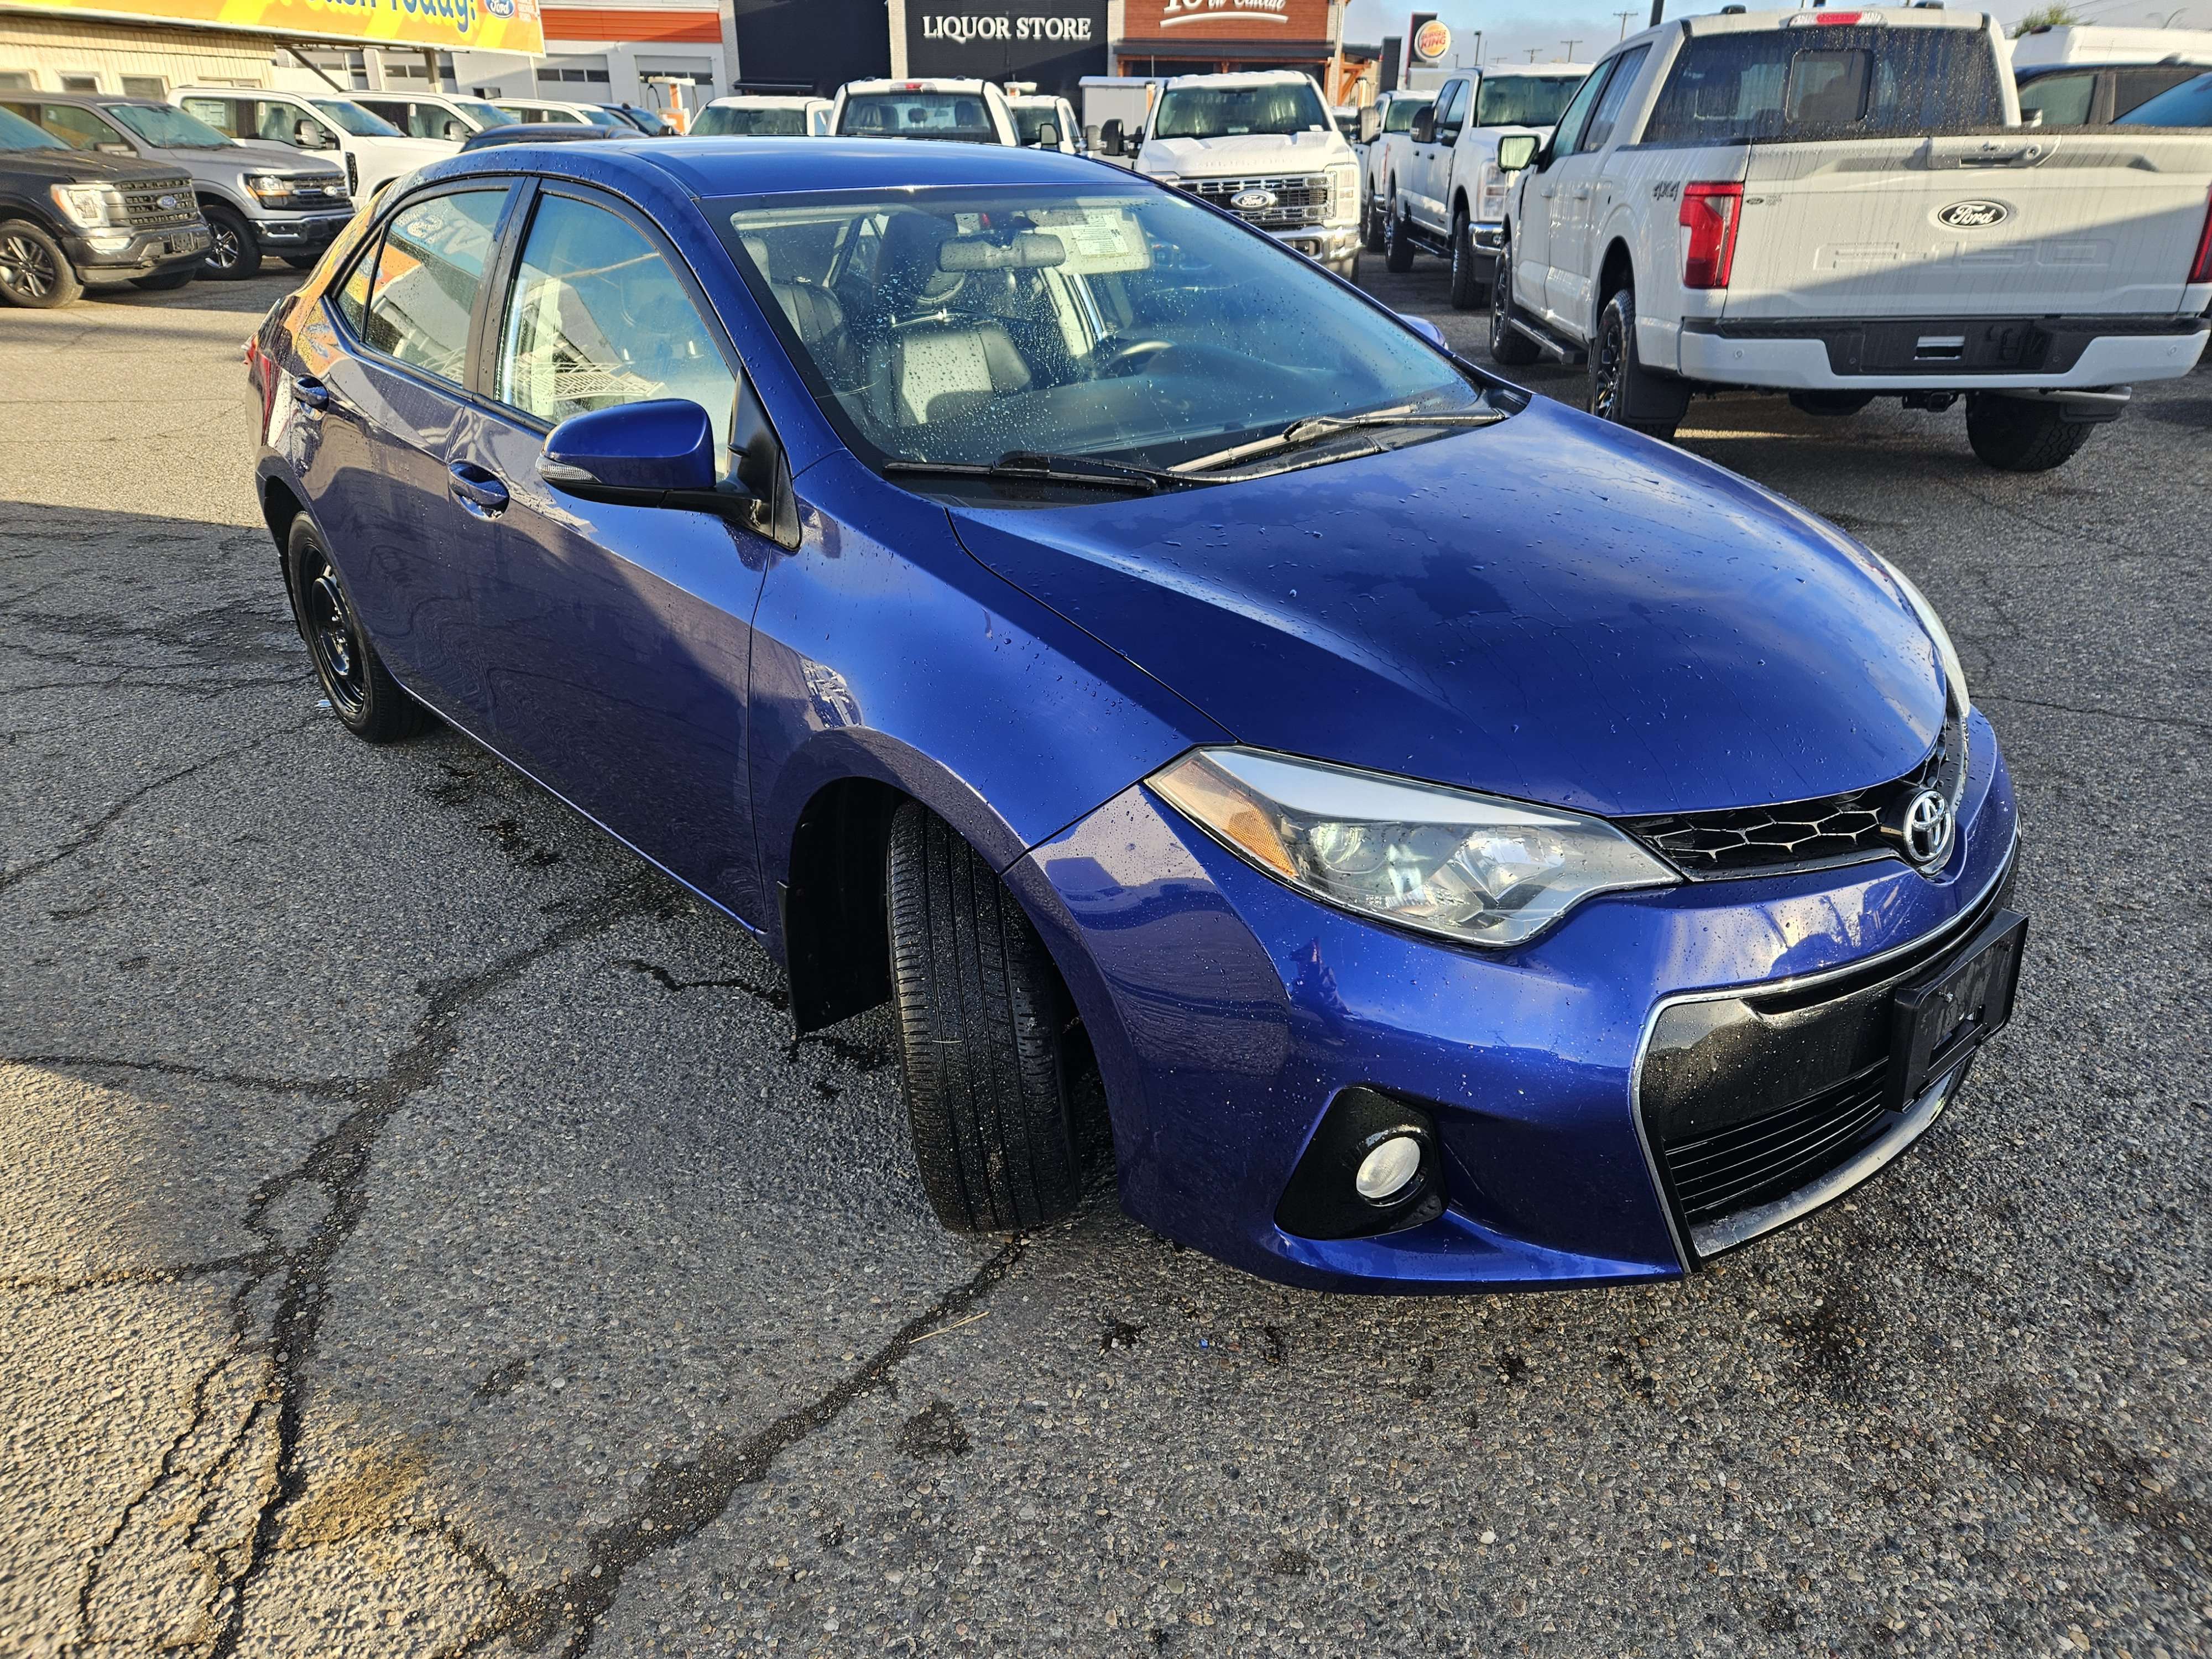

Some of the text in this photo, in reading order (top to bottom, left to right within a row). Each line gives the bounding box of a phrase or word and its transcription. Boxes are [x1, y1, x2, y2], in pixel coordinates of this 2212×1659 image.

[922, 15, 1092, 44] LIQUOR STORE
[1421, 36, 1446, 49] KING
[1949, 204, 1996, 226] Ford
[1812, 240, 2114, 271] F-150
